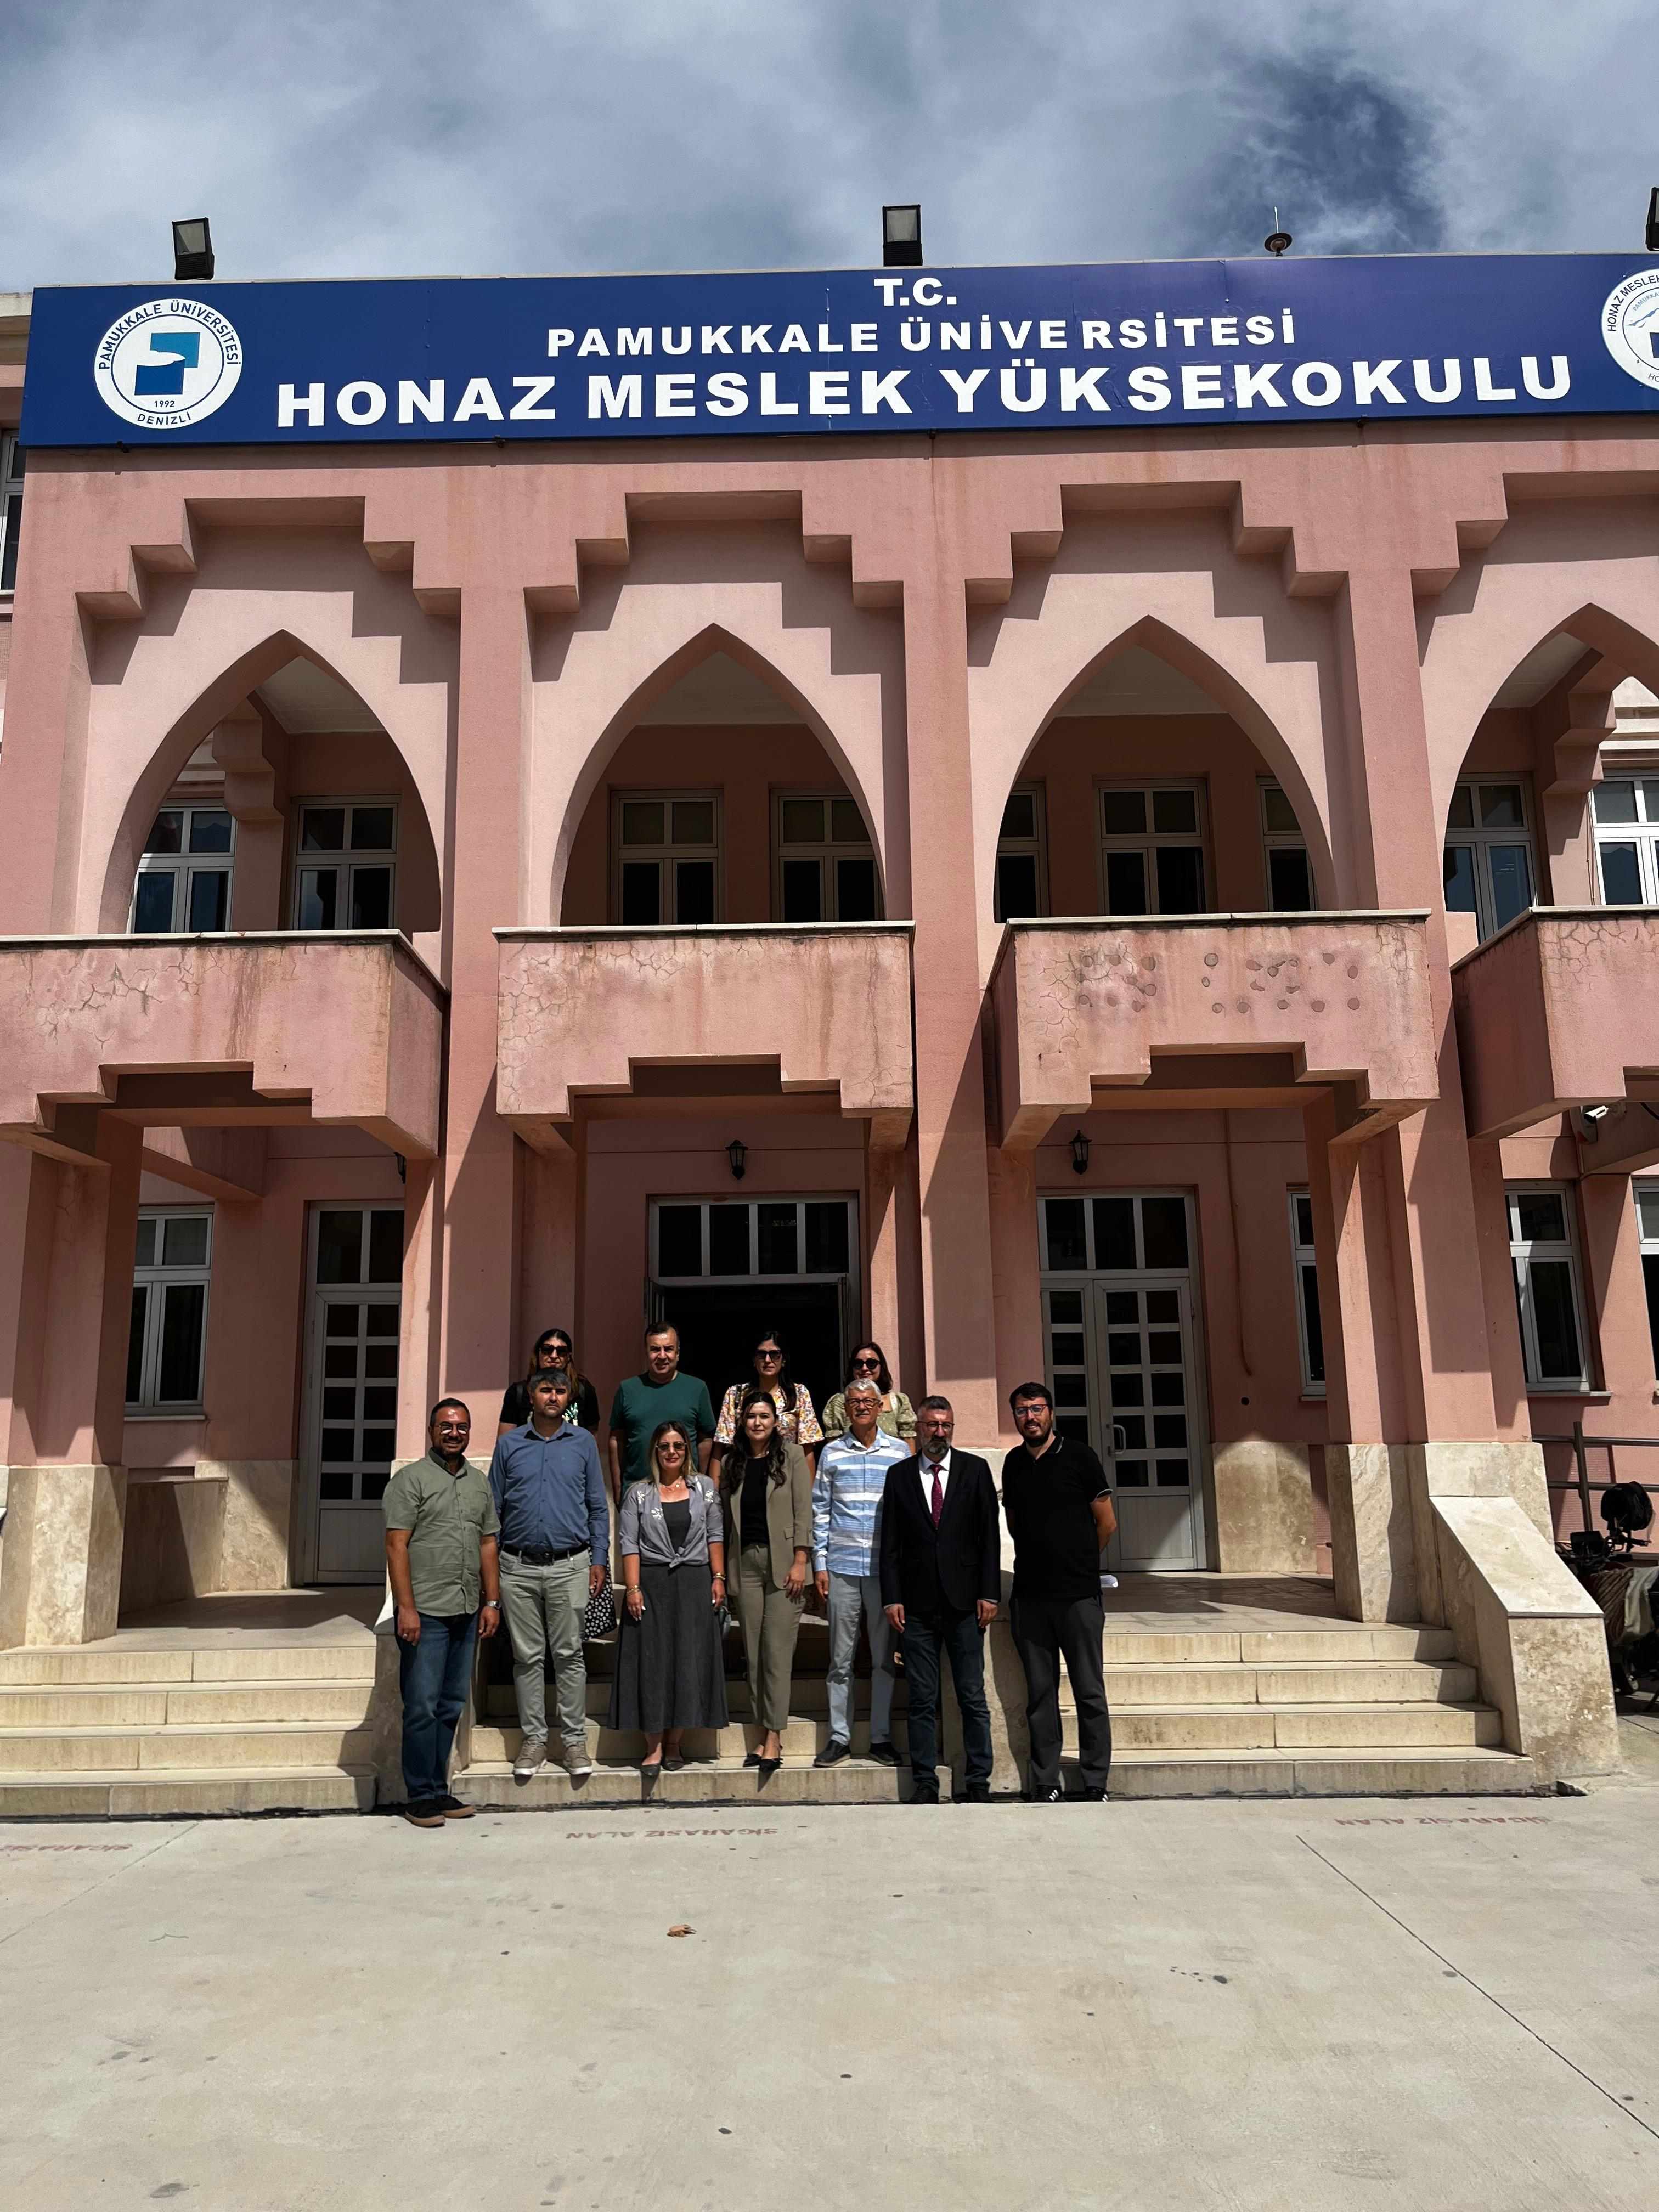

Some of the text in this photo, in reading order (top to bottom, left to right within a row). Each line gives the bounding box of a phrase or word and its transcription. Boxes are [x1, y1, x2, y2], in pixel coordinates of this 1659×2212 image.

[874, 277, 957, 306] T.C.
[548, 308, 1295, 357] PAMUKKALE ÜNİVERSİTESİ
[1607, 295, 1624, 331] HONAZ
[99, 300, 241, 369] PAMUKKALE ÜNİVERSİTESİ
[278, 356, 1570, 427] HONAZ MESLEK YÜKSEKOKULU
[137, 411, 191, 425] DENİZLİ
